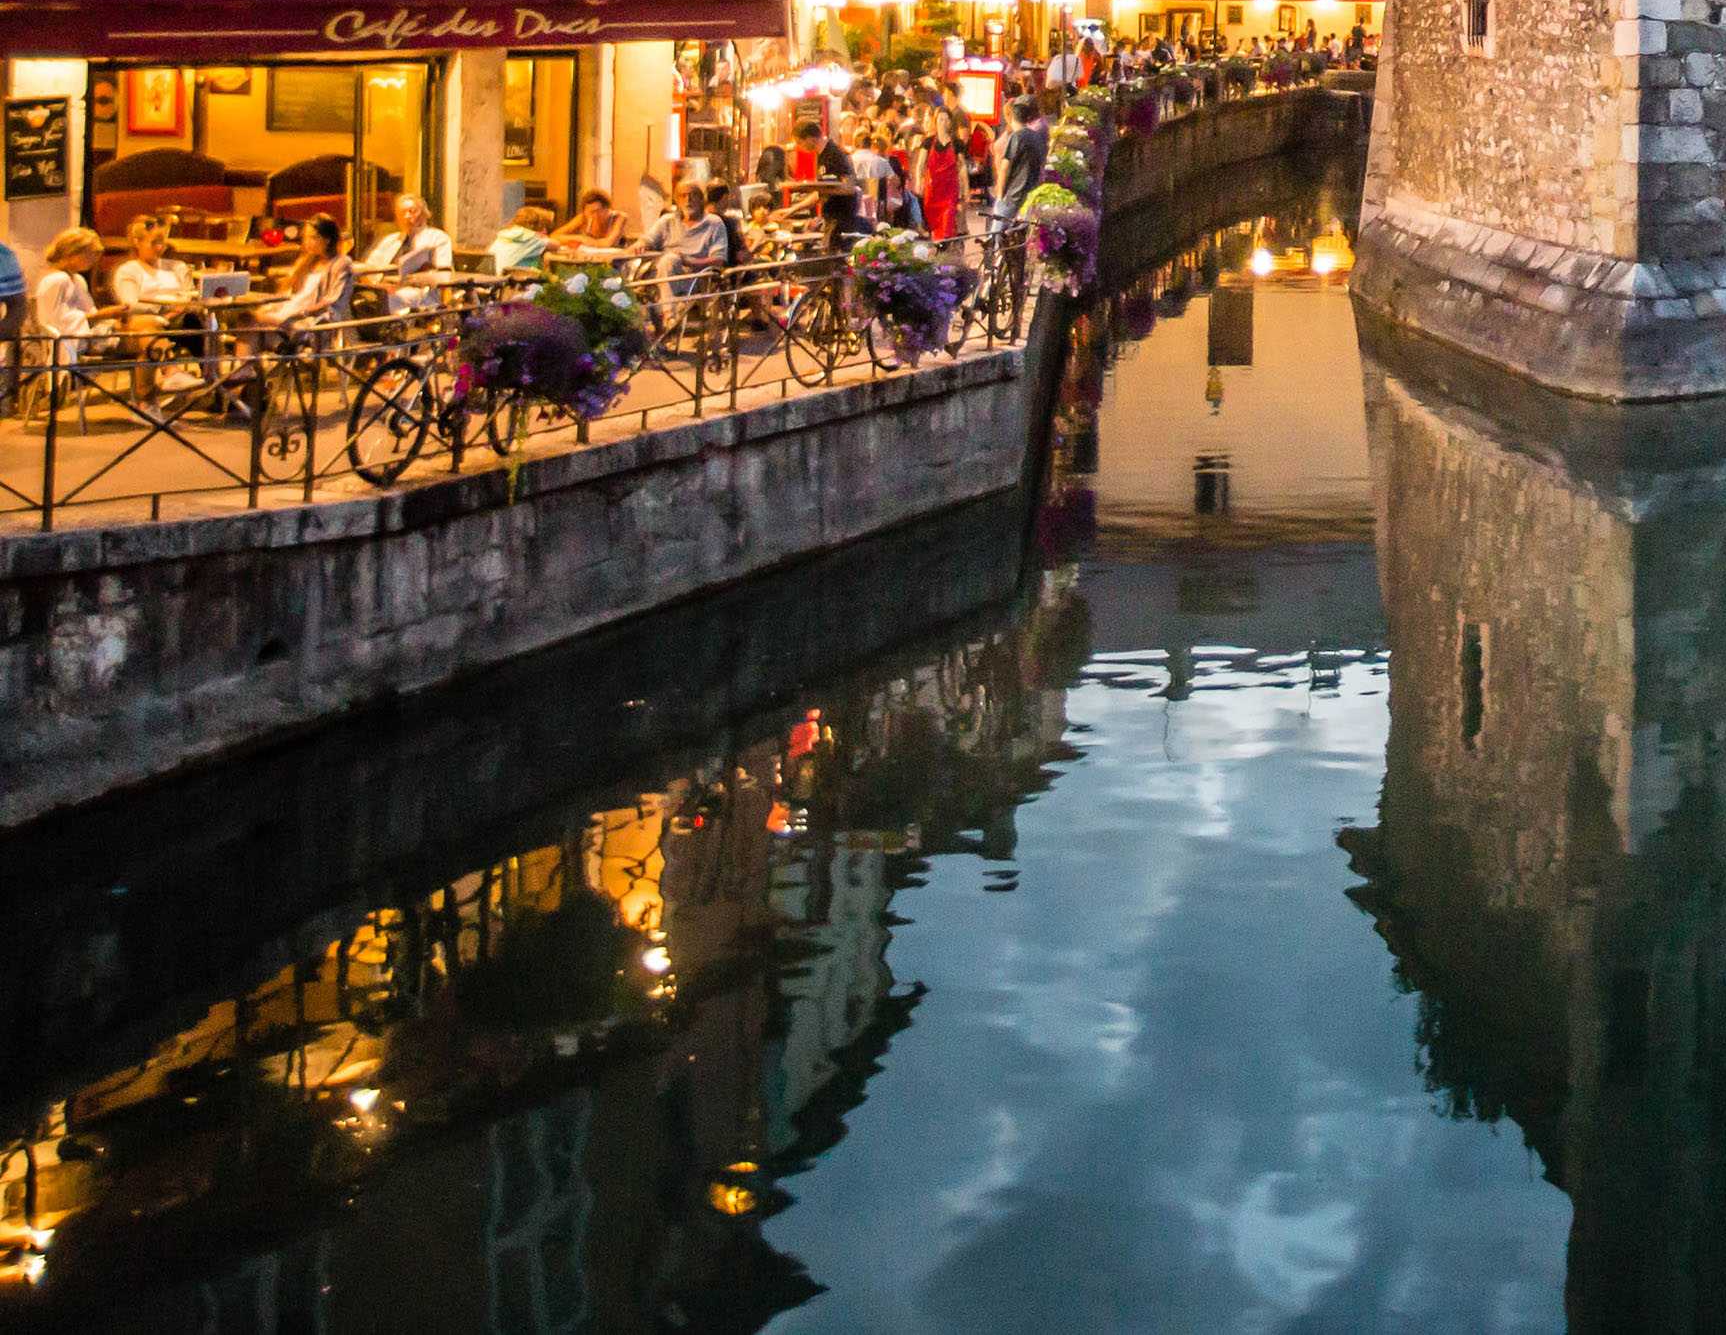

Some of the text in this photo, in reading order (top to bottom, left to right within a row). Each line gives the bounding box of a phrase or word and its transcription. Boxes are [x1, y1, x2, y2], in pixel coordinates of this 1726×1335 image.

[324, 7, 602, 49] Café des Ducs
